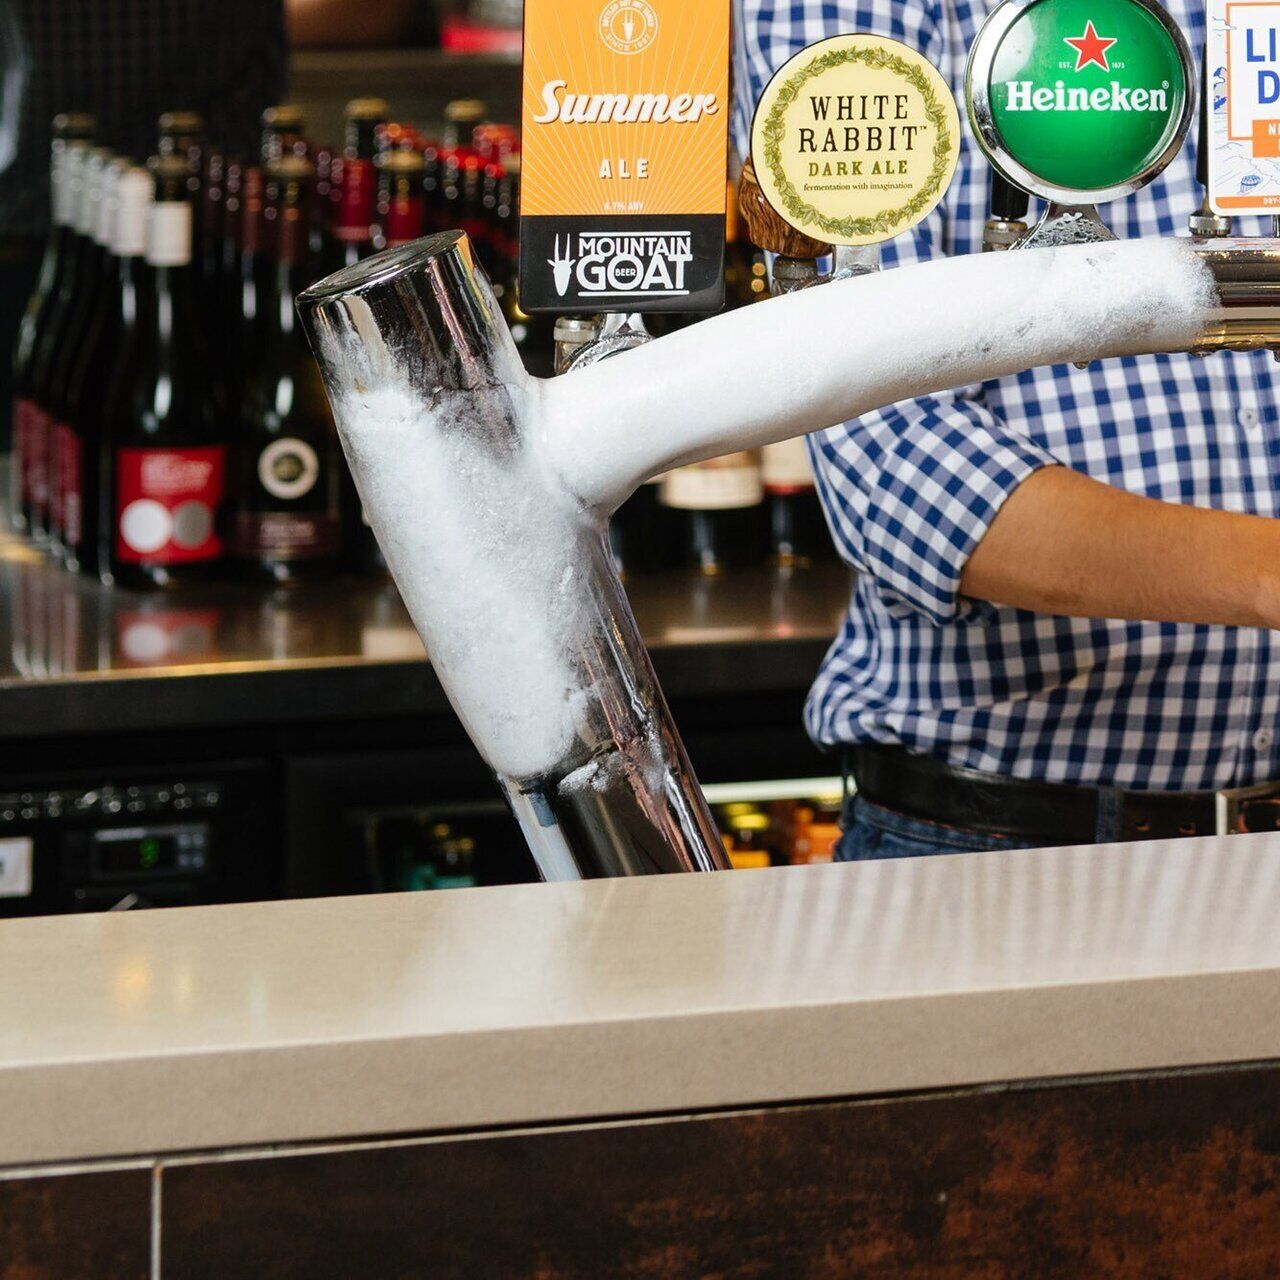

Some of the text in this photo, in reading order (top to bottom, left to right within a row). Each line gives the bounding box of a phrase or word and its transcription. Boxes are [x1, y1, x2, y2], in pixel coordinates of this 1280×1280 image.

[1058, 61, 1073, 69] EST.
[532, 79, 719, 124] Summer
[1005, 80, 1168, 112] Heineken
[809, 95, 908, 120] WHITE
[600, 158, 649, 180] ALE
[809, 160, 908, 176] DARK ALE
[804, 181, 913, 191] fermentation with imagination
[579, 237, 691, 257] MOUNTAIN
[576, 253, 693, 290] GOAT
[615, 268, 637, 277] BEER
